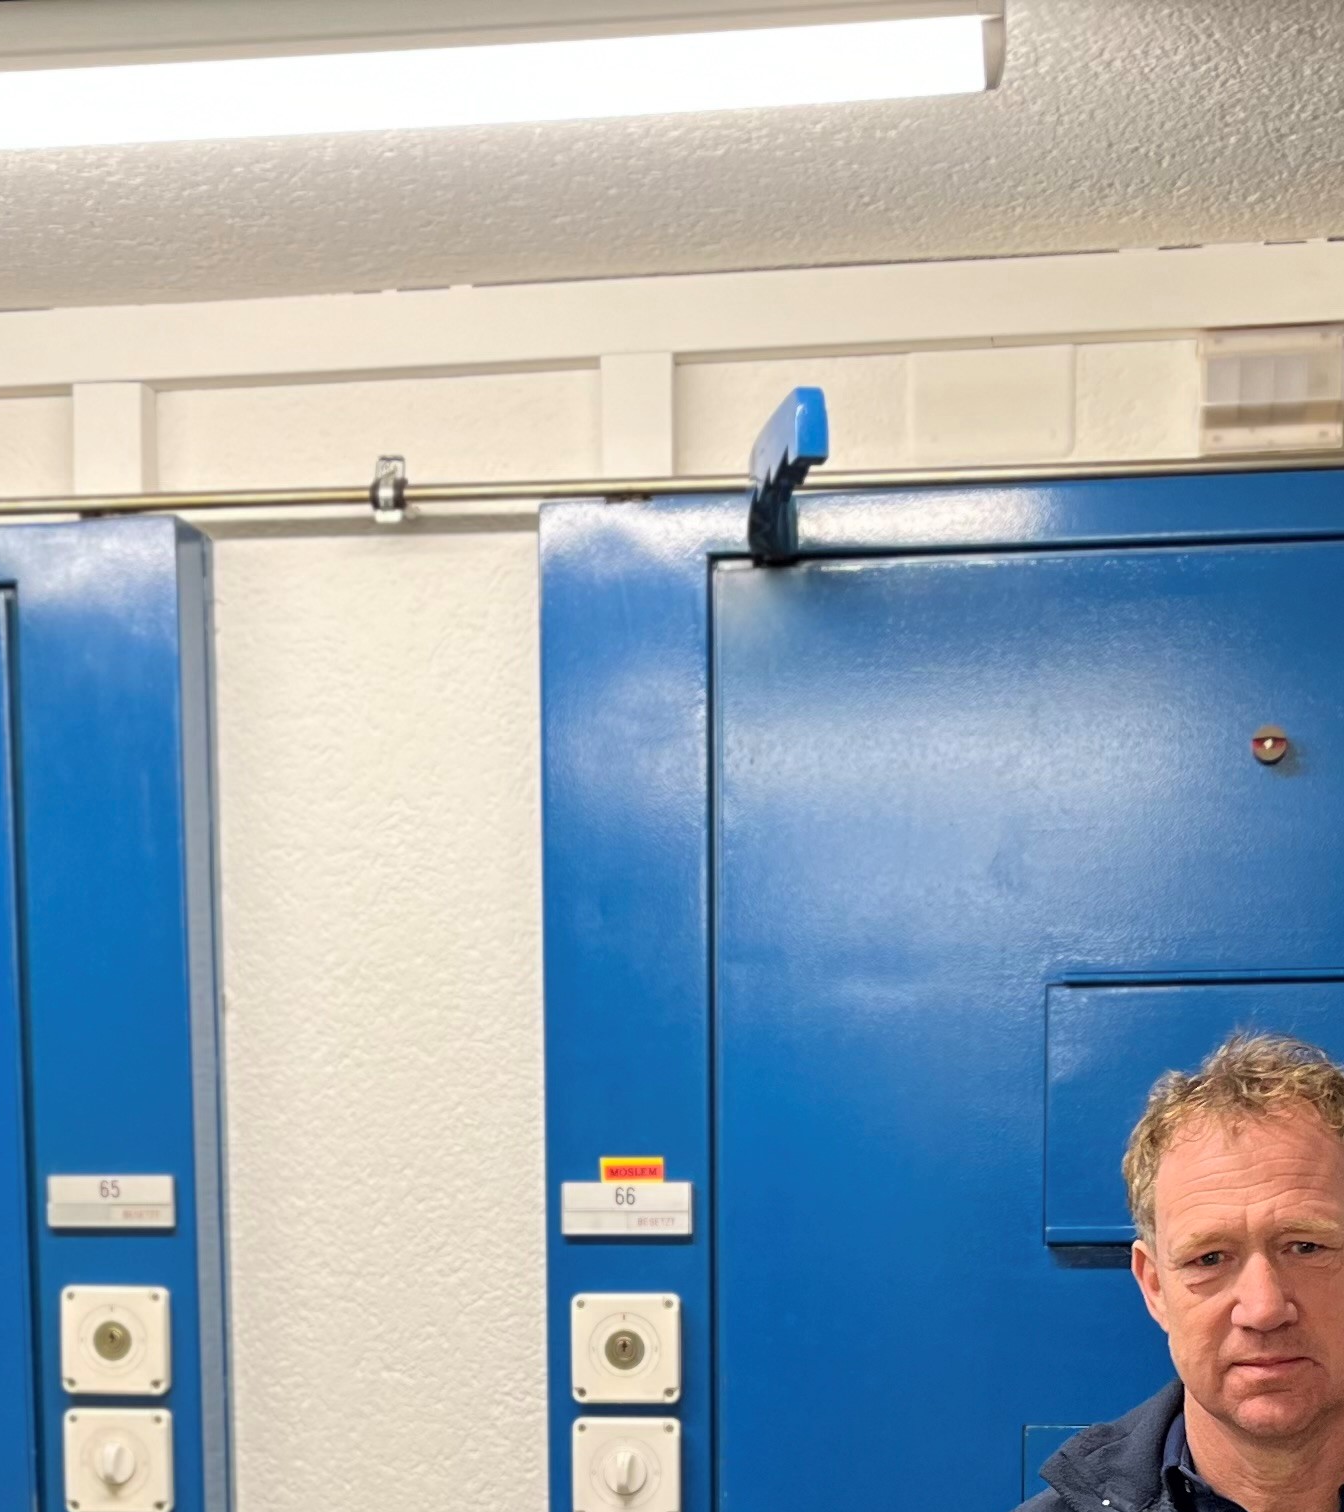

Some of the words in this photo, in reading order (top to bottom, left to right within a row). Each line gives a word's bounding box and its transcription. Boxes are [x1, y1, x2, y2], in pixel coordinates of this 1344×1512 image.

[609, 1167, 658, 1177] MOSLEM
[99, 1179, 121, 1199] 65
[615, 1186, 636, 1205] 66
